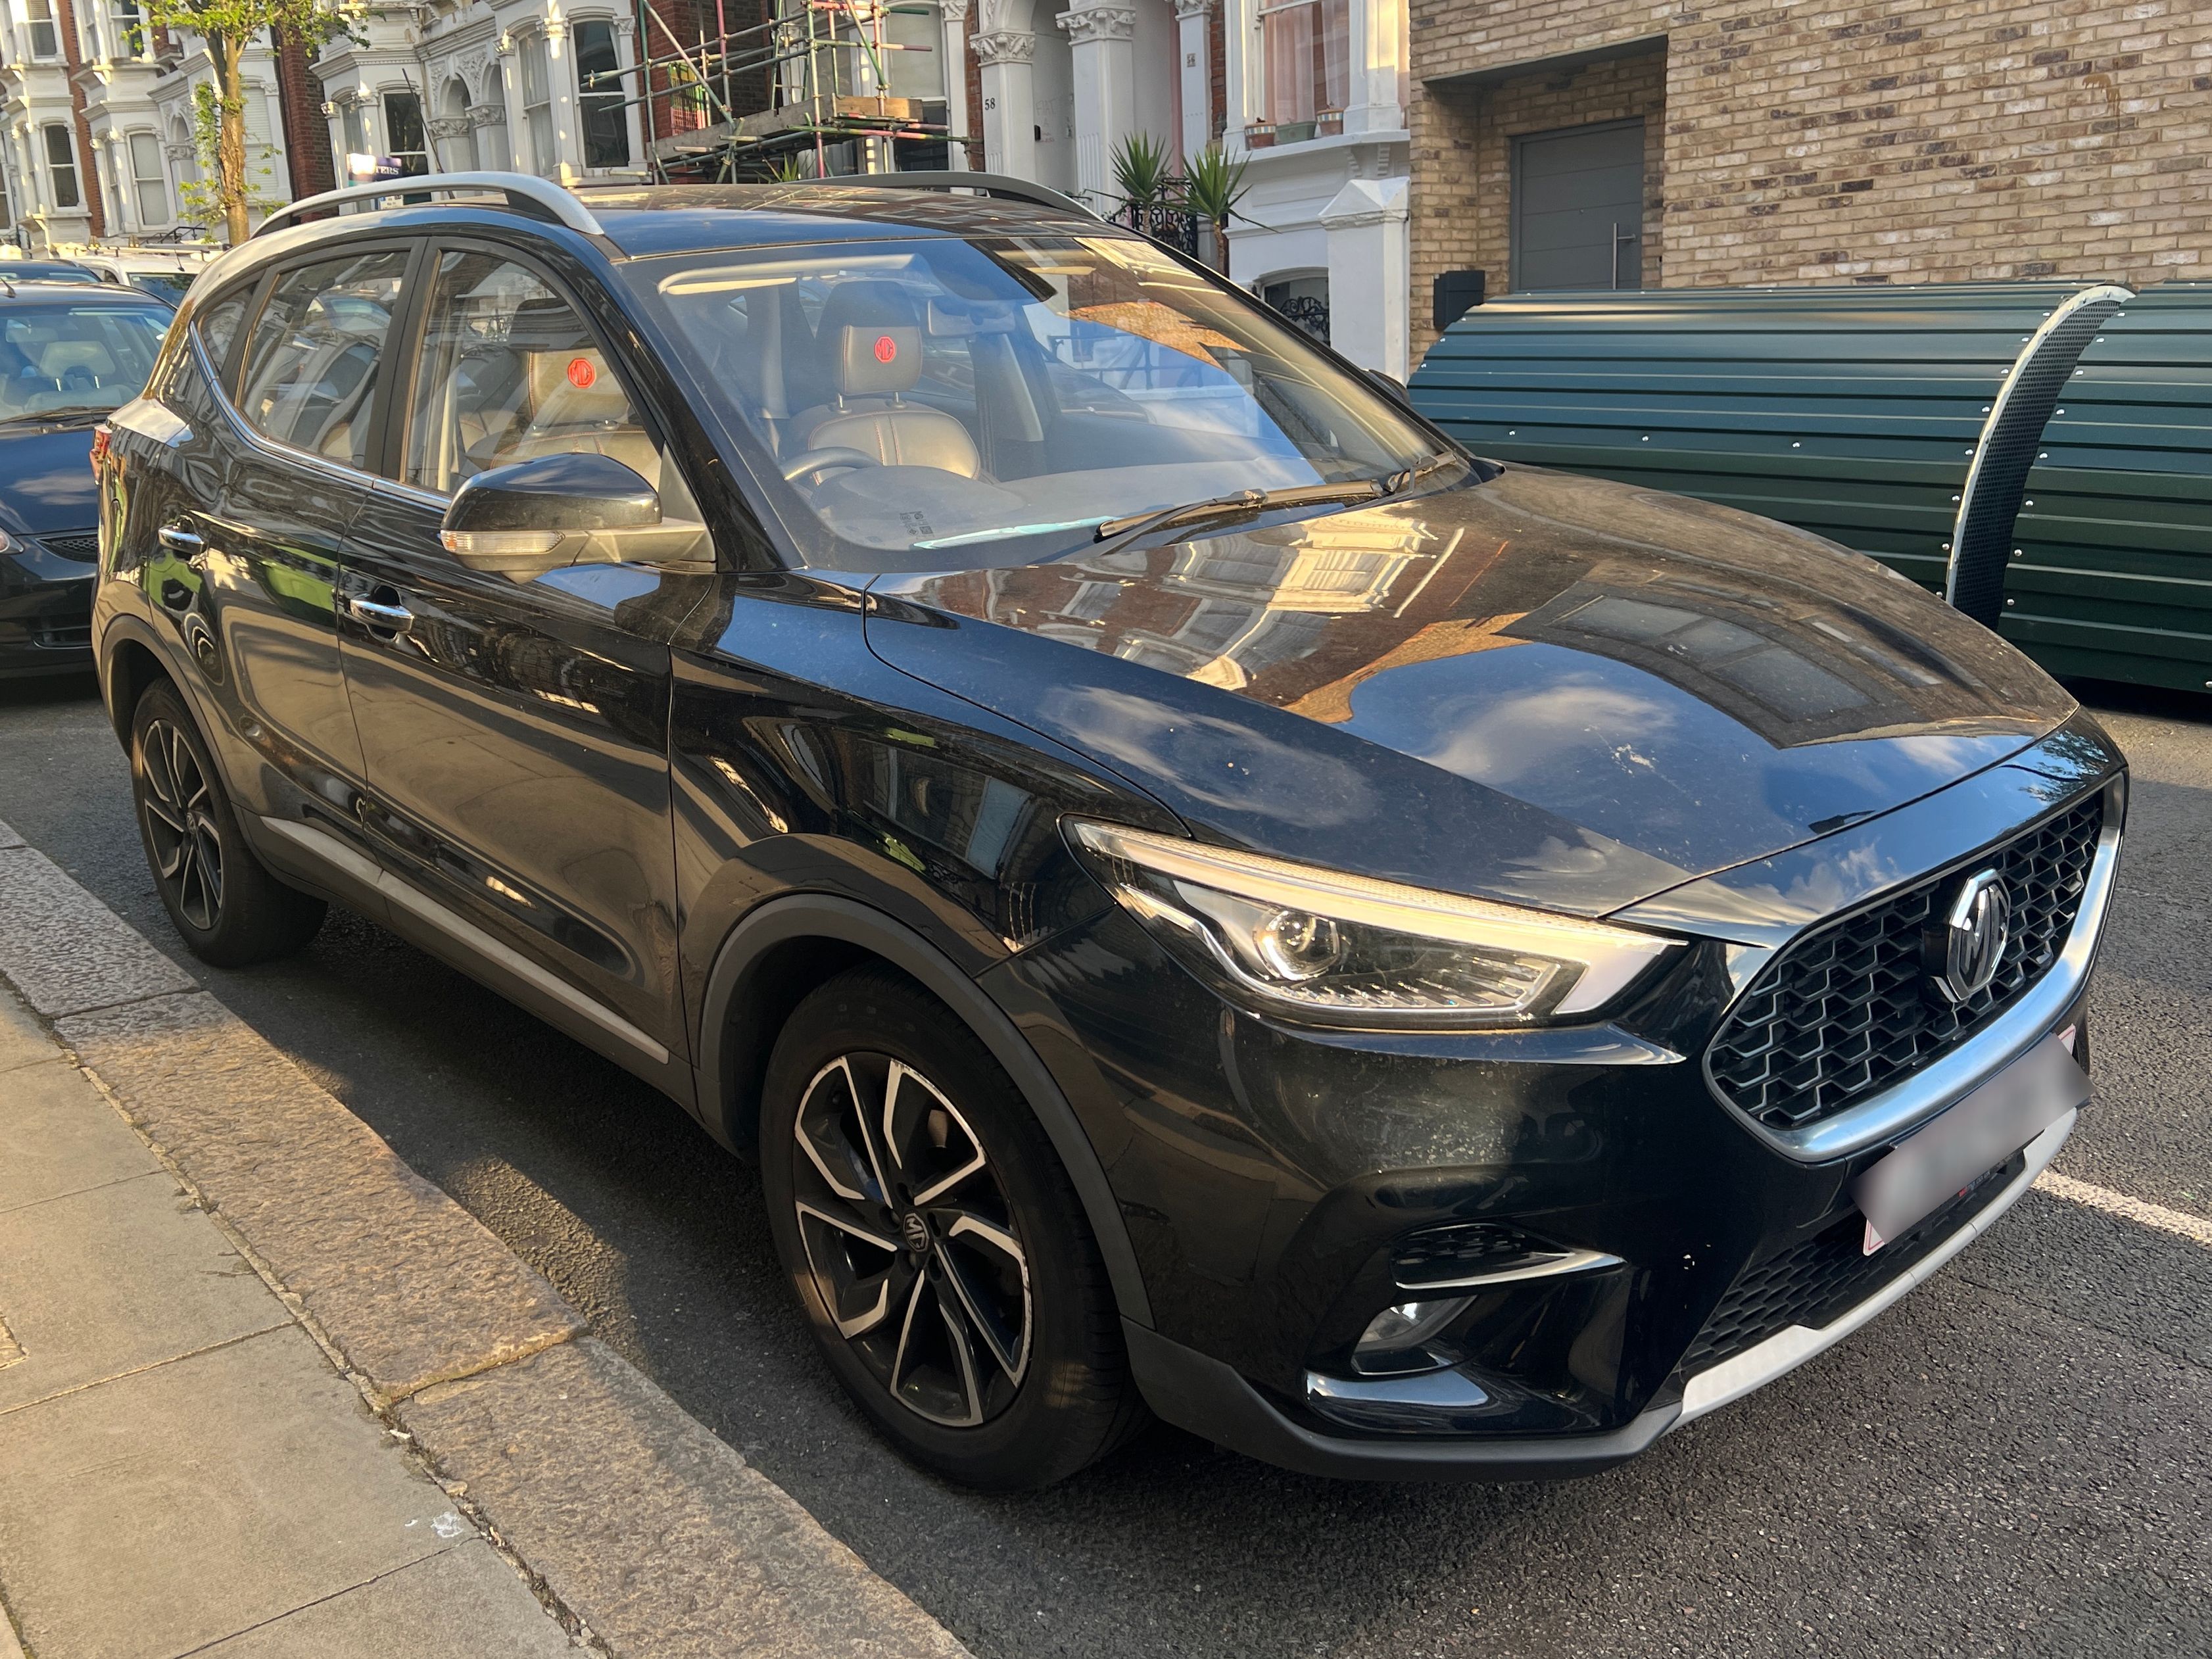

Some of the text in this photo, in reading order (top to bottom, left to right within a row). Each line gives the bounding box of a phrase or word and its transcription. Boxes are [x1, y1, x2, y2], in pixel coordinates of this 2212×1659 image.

[984, 97, 996, 110] 58
[876, 337, 894, 360] MG
[569, 360, 593, 385] MG
[1958, 882, 2008, 986] MG
[905, 1216, 926, 1249] MG
